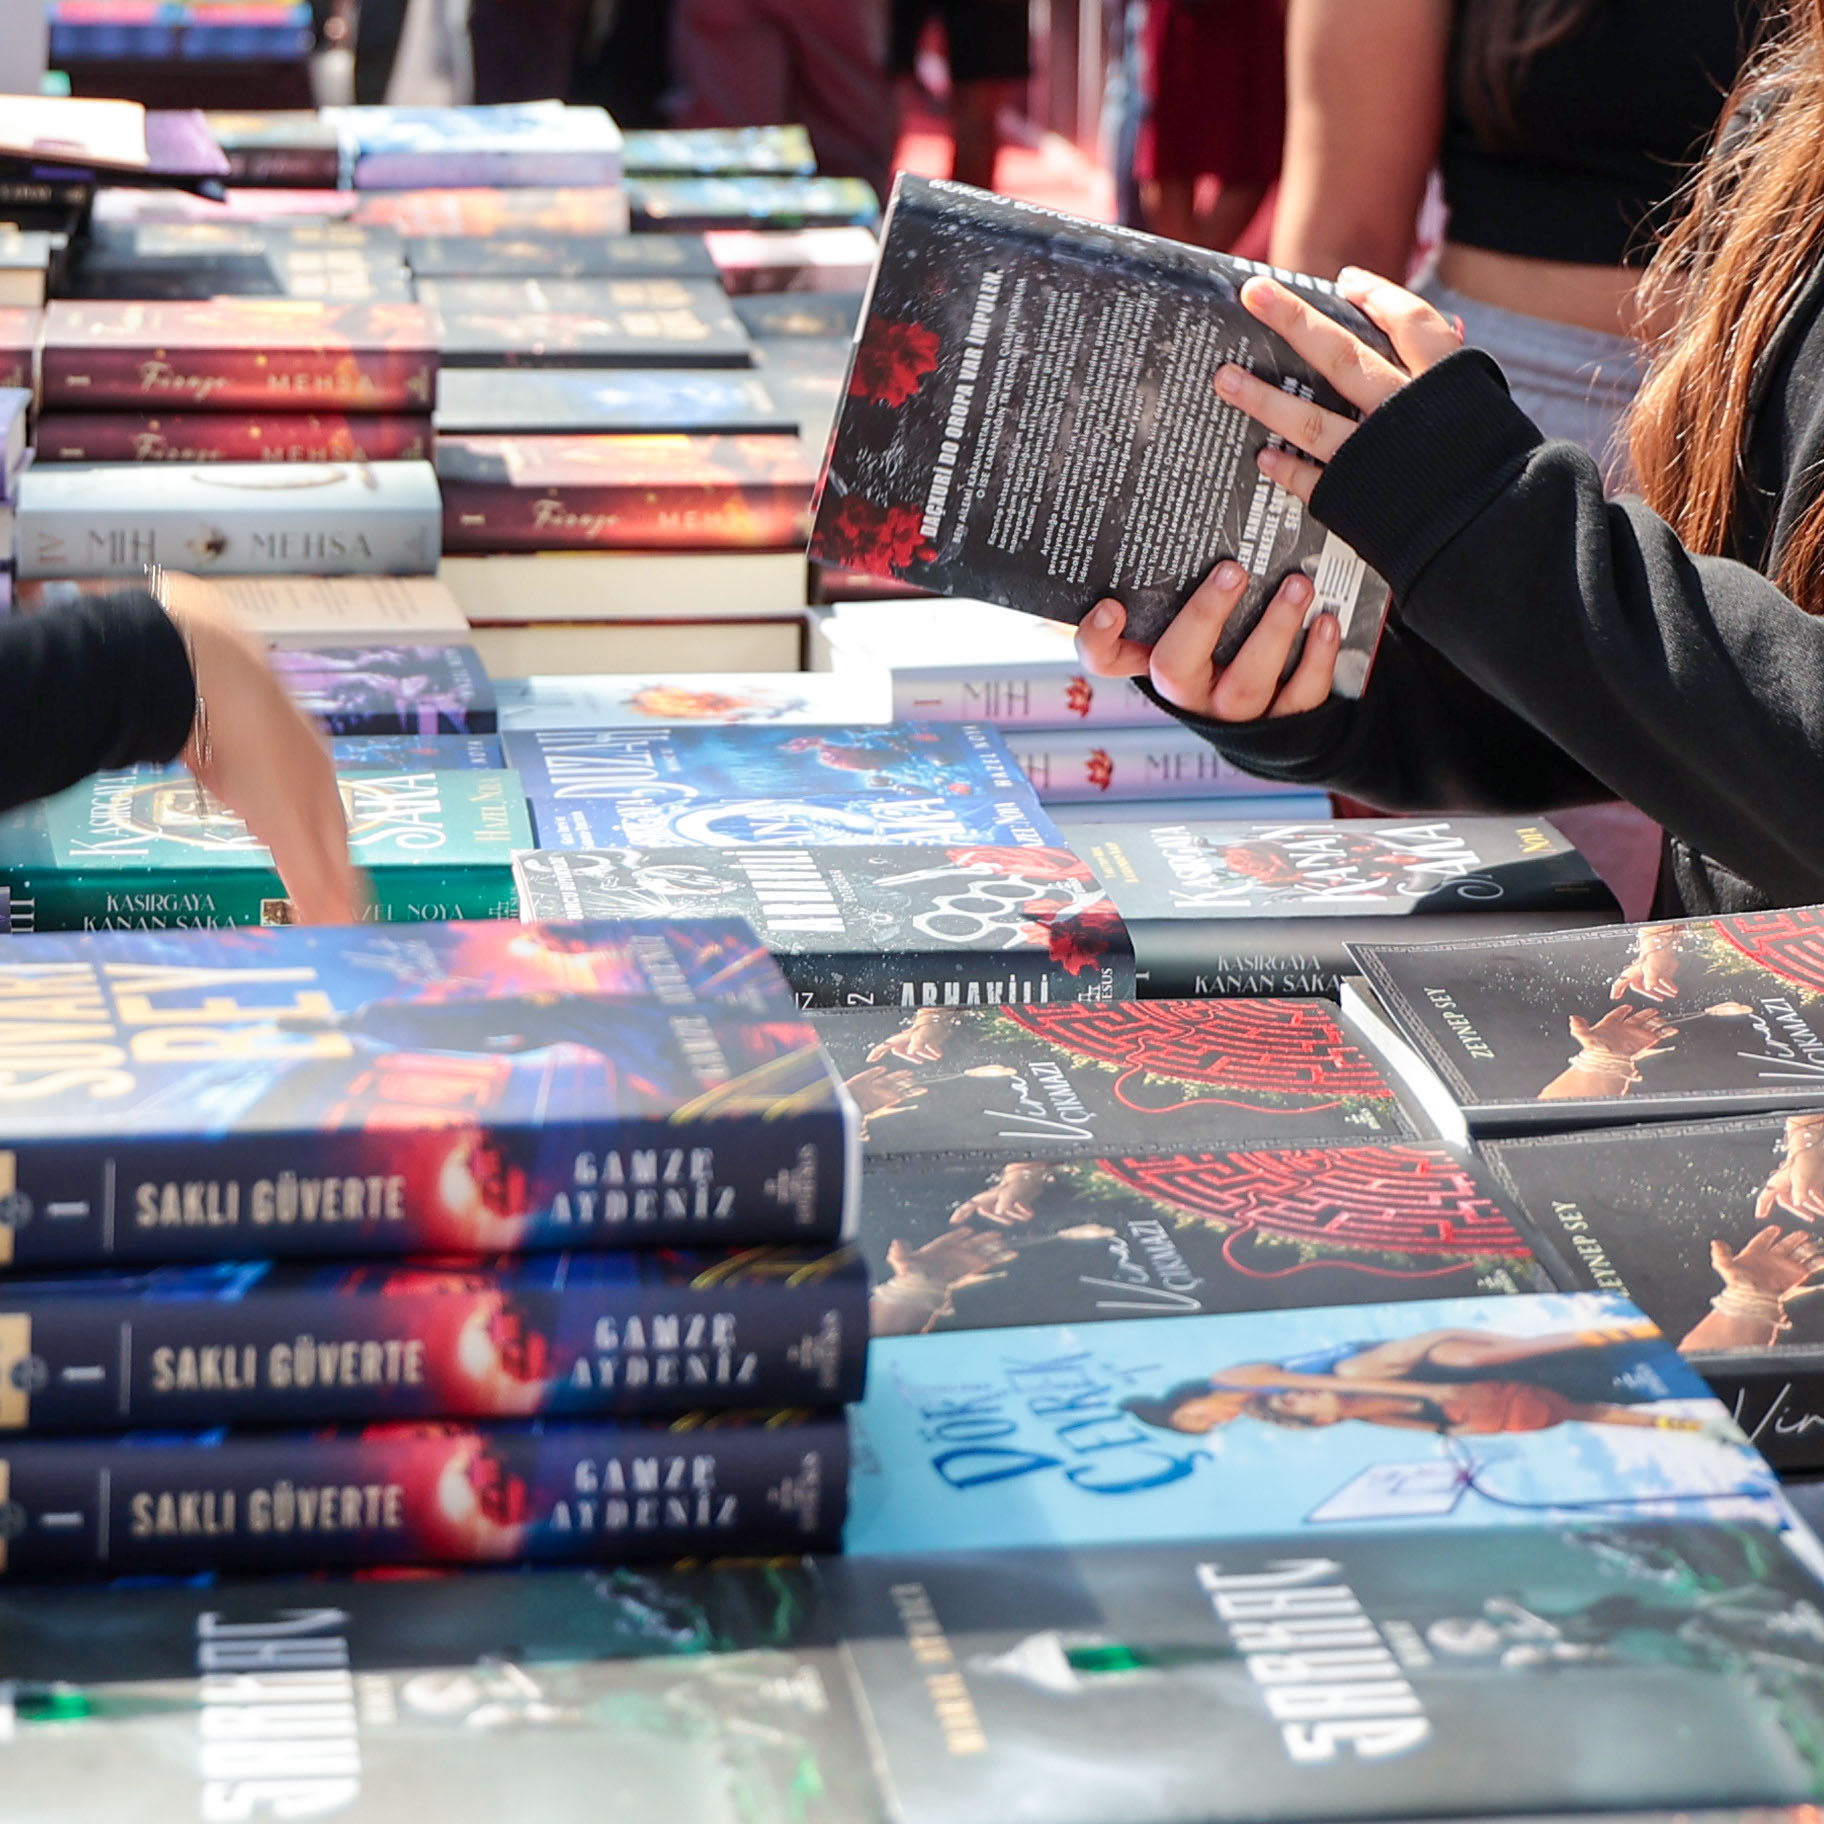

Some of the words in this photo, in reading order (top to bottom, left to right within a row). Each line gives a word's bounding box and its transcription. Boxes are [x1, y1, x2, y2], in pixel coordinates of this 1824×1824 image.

[958, 345, 983, 383] VAR
[943, 381, 974, 440] OROPA
[938, 439, 960, 466] DO
[951, 522, 964, 544] BEN
[871, 797, 968, 848] AKA
[1253, 824, 1391, 906] KANAN
[1371, 821, 1506, 901] SAKA
[105, 891, 217, 913] KASIRGAYA
[1194, 972, 1278, 995] KANAN
[1282, 970, 1343, 994] SAKA
[1216, 953, 1323, 978] KASIRGAYA
[104, 963, 356, 1060] BEY
[572, 1146, 714, 1186] GAMZE
[135, 1180, 240, 1227] SAKLI
[251, 1168, 407, 1226] GÜVERTE
[593, 1312, 736, 1351] GAMZE
[151, 1344, 257, 1391] SAKLI
[268, 1333, 426, 1390] GÜVERTE
[574, 1454, 716, 1493] GAMZE
[130, 1491, 237, 1537] SAKLI
[247, 1479, 405, 1535] GÜVERTE
